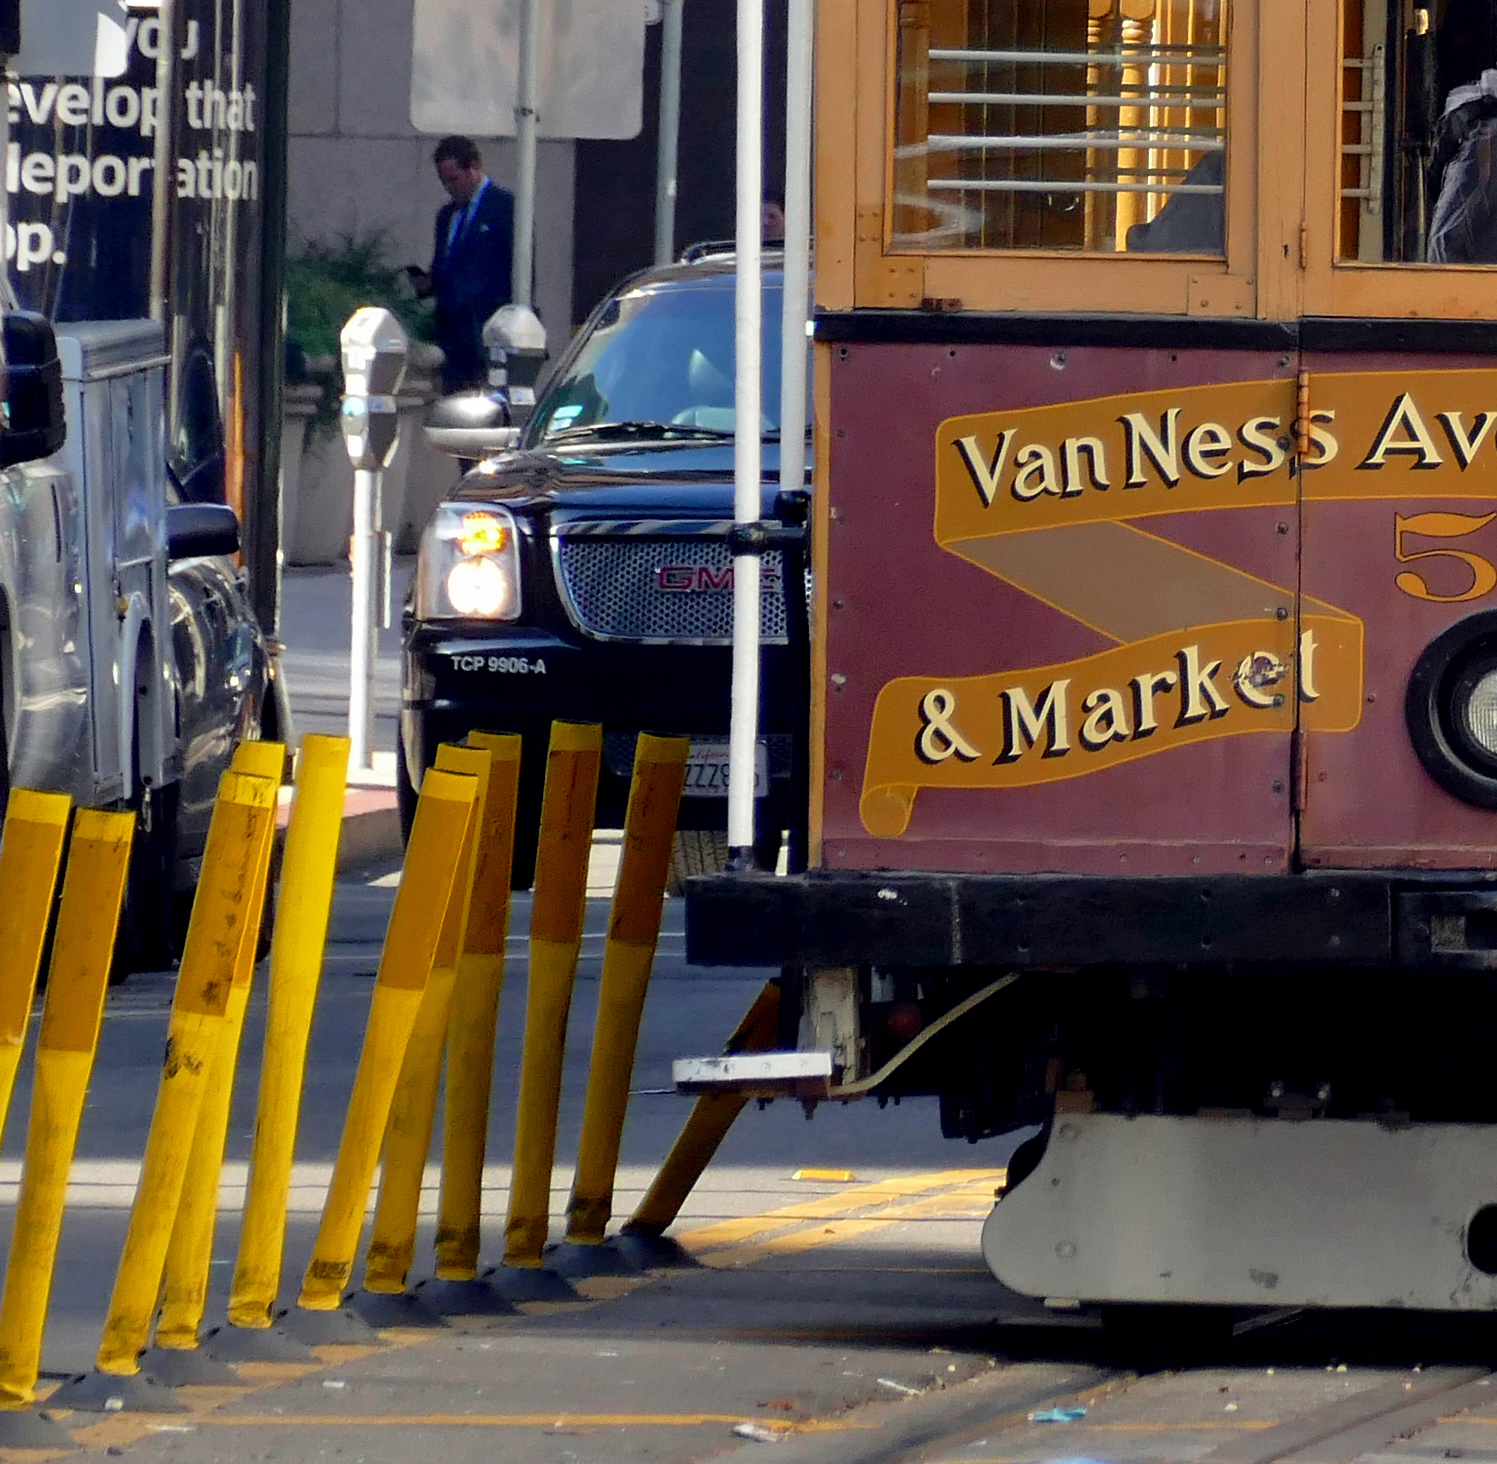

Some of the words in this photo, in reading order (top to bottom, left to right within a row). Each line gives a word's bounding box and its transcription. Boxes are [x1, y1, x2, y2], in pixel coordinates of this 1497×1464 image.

[185, 79, 256, 131] that
[7, 142, 259, 204] leporation
[952, 425, 1110, 508] Van
[1118, 406, 1339, 491] Ness
[450, 655, 485, 672] TCP
[487, 655, 547, 675] 9906-A
[914, 685, 981, 766] &
[993, 626, 1320, 766] Market
